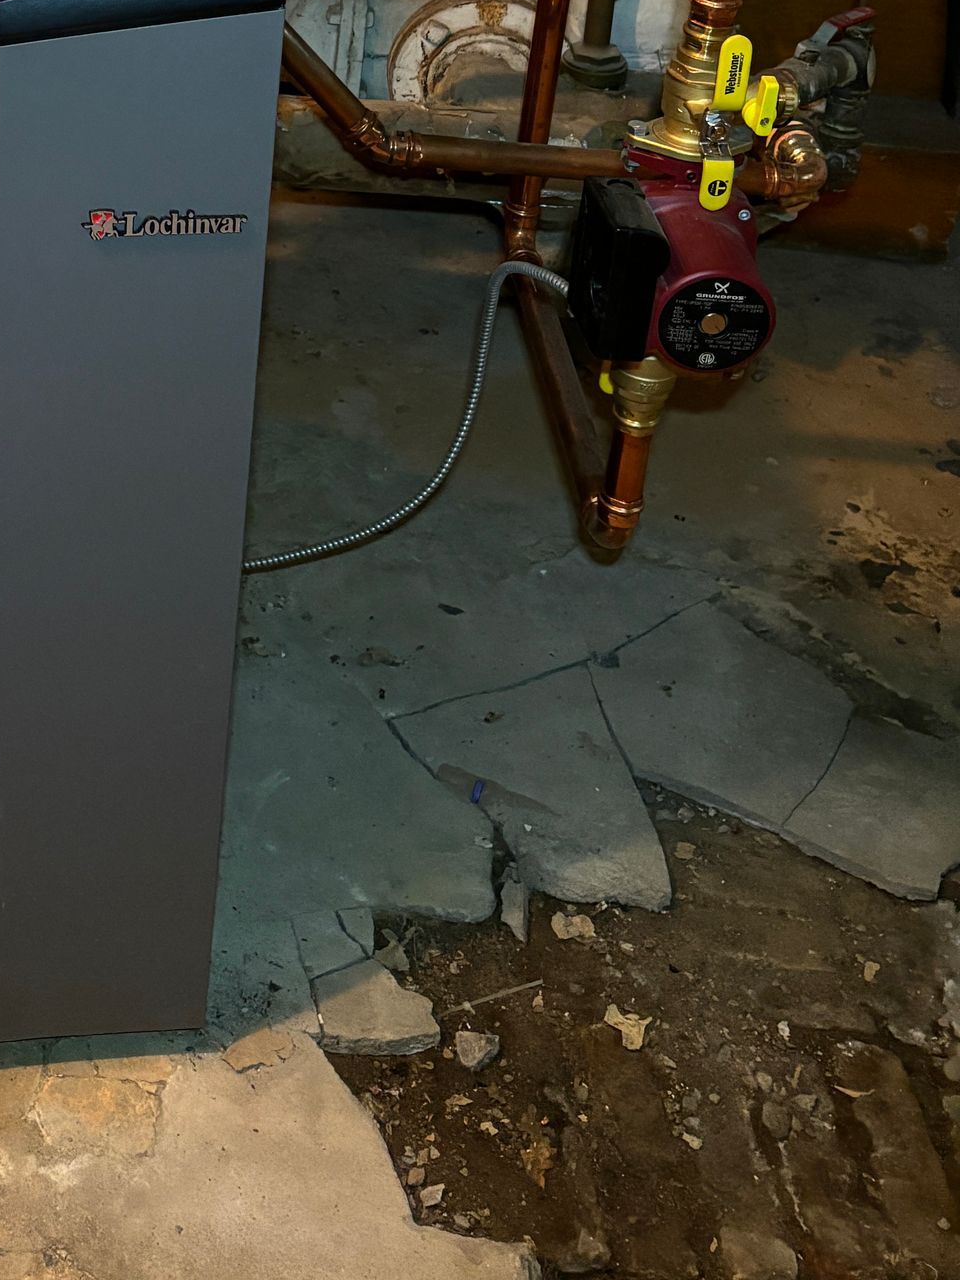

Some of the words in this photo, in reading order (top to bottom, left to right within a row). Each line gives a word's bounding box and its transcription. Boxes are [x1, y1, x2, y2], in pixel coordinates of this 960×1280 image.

[725, 54, 740, 95] Webstone
[123, 209, 248, 237] Lochinvar
[696, 292, 744, 301] GRUNDFOS
